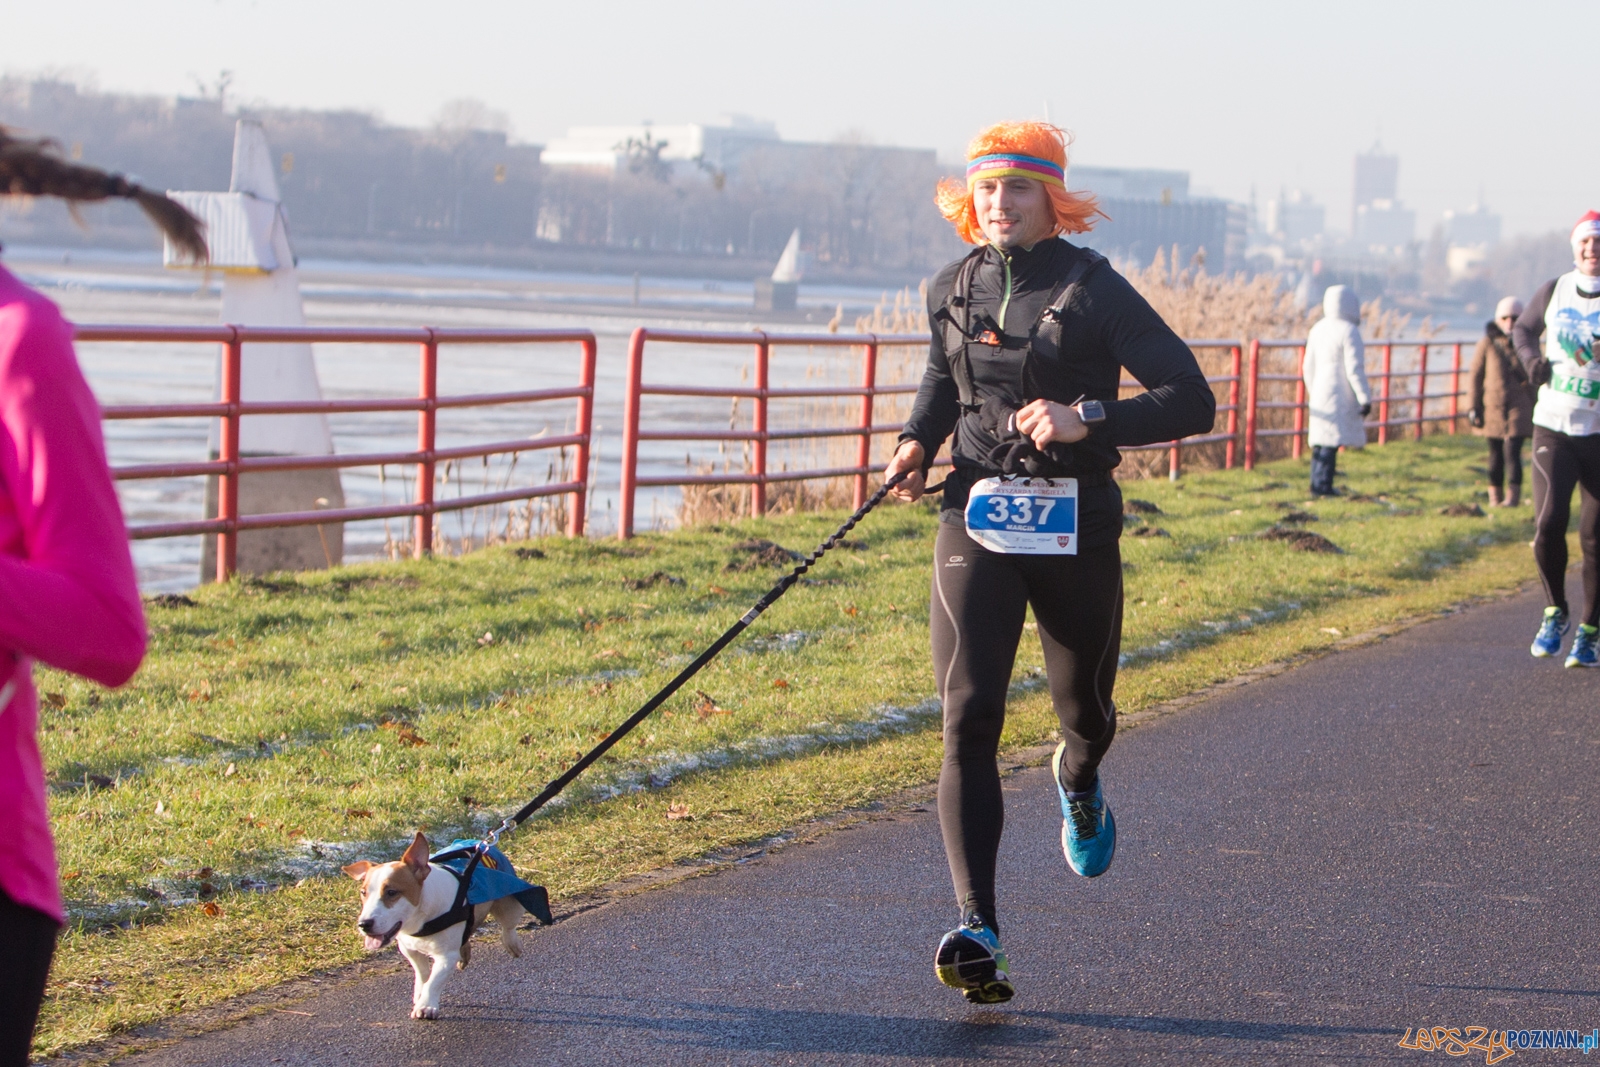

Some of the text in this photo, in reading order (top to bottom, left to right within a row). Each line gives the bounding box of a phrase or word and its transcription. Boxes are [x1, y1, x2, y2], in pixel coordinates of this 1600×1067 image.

[1559, 376, 1592, 395] 715
[987, 496, 1056, 525] 337
[1006, 524, 1036, 532] MARCIN
